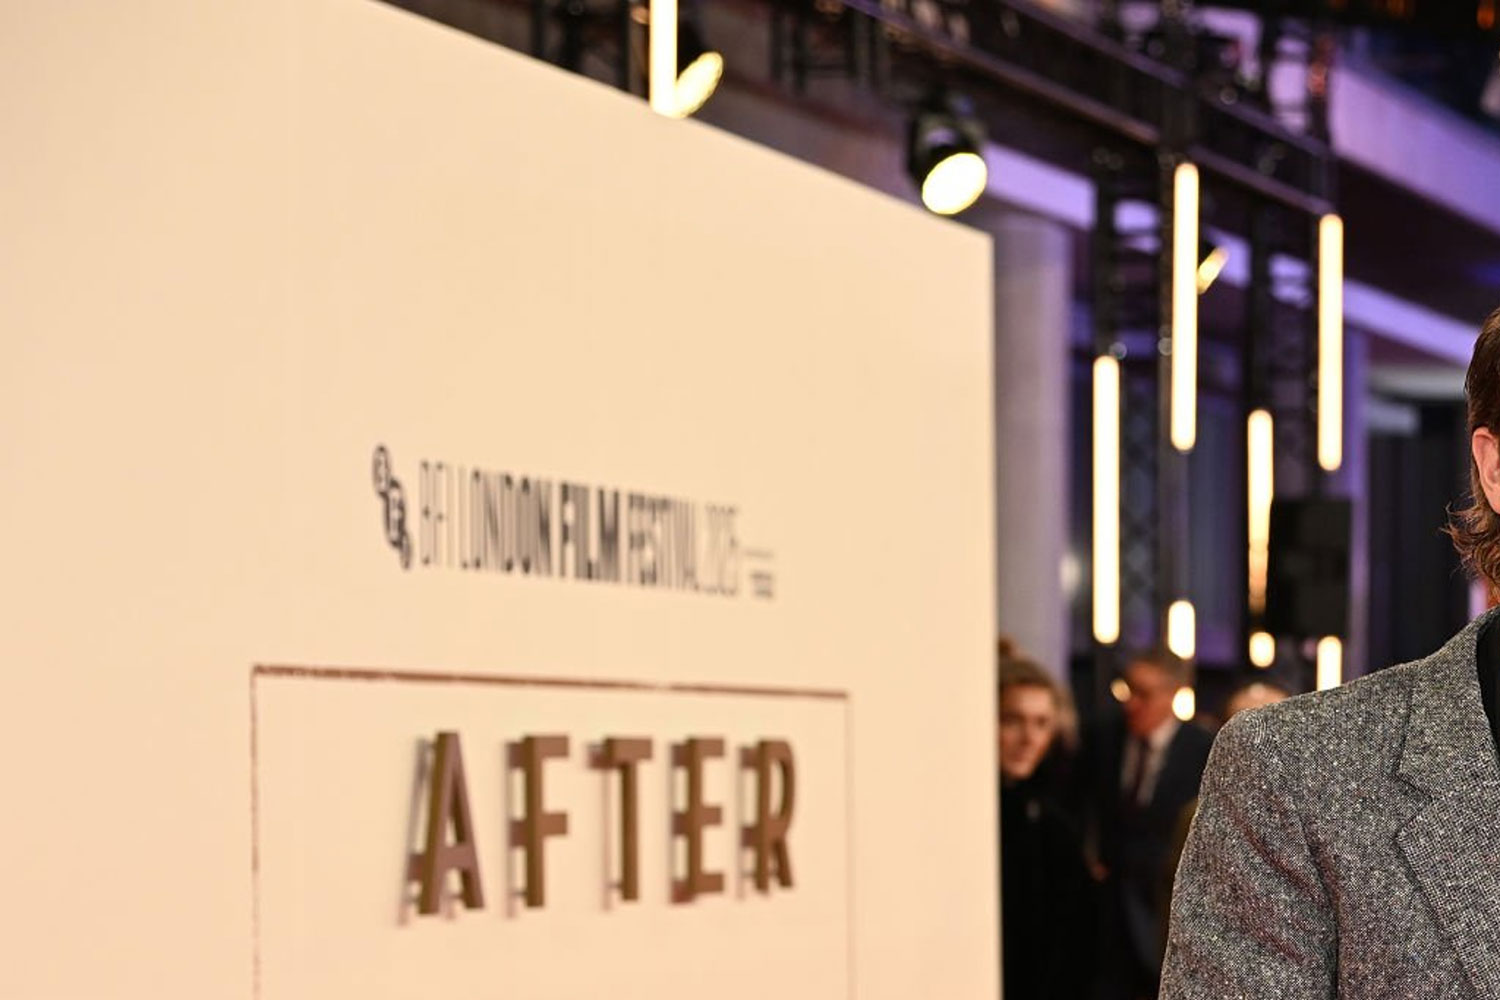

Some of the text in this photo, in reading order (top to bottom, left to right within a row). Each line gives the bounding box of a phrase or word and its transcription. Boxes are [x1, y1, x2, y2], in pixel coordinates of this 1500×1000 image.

[419, 459, 455, 569] BFI
[457, 466, 554, 578] LONDON
[559, 480, 621, 585] FILM
[626, 491, 699, 592] FESTIVAL
[404, 731, 796, 918] AFTER
